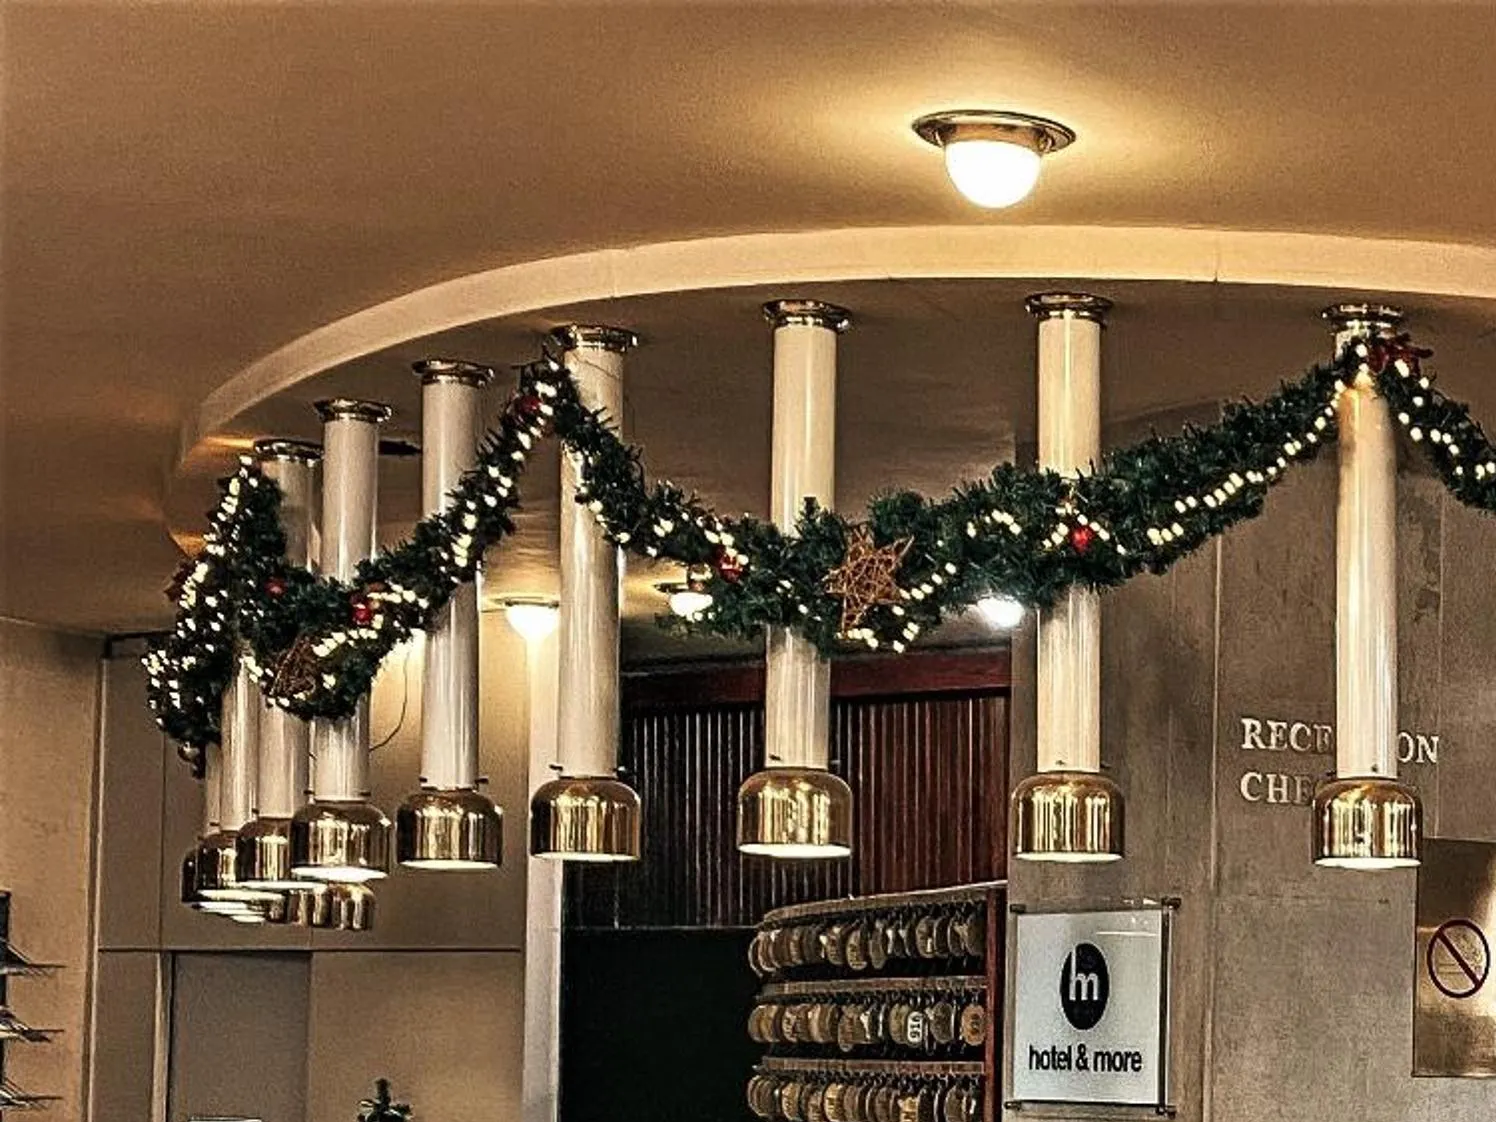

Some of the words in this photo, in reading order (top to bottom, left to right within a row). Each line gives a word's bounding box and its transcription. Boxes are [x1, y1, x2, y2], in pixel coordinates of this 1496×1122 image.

[1240, 717, 1440, 764] RECEON
[1240, 771, 1314, 806] CHE
[1029, 1044, 1072, 1070] hotel
[1075, 1043, 1090, 1071] &
[1093, 1050, 1143, 1072] more
